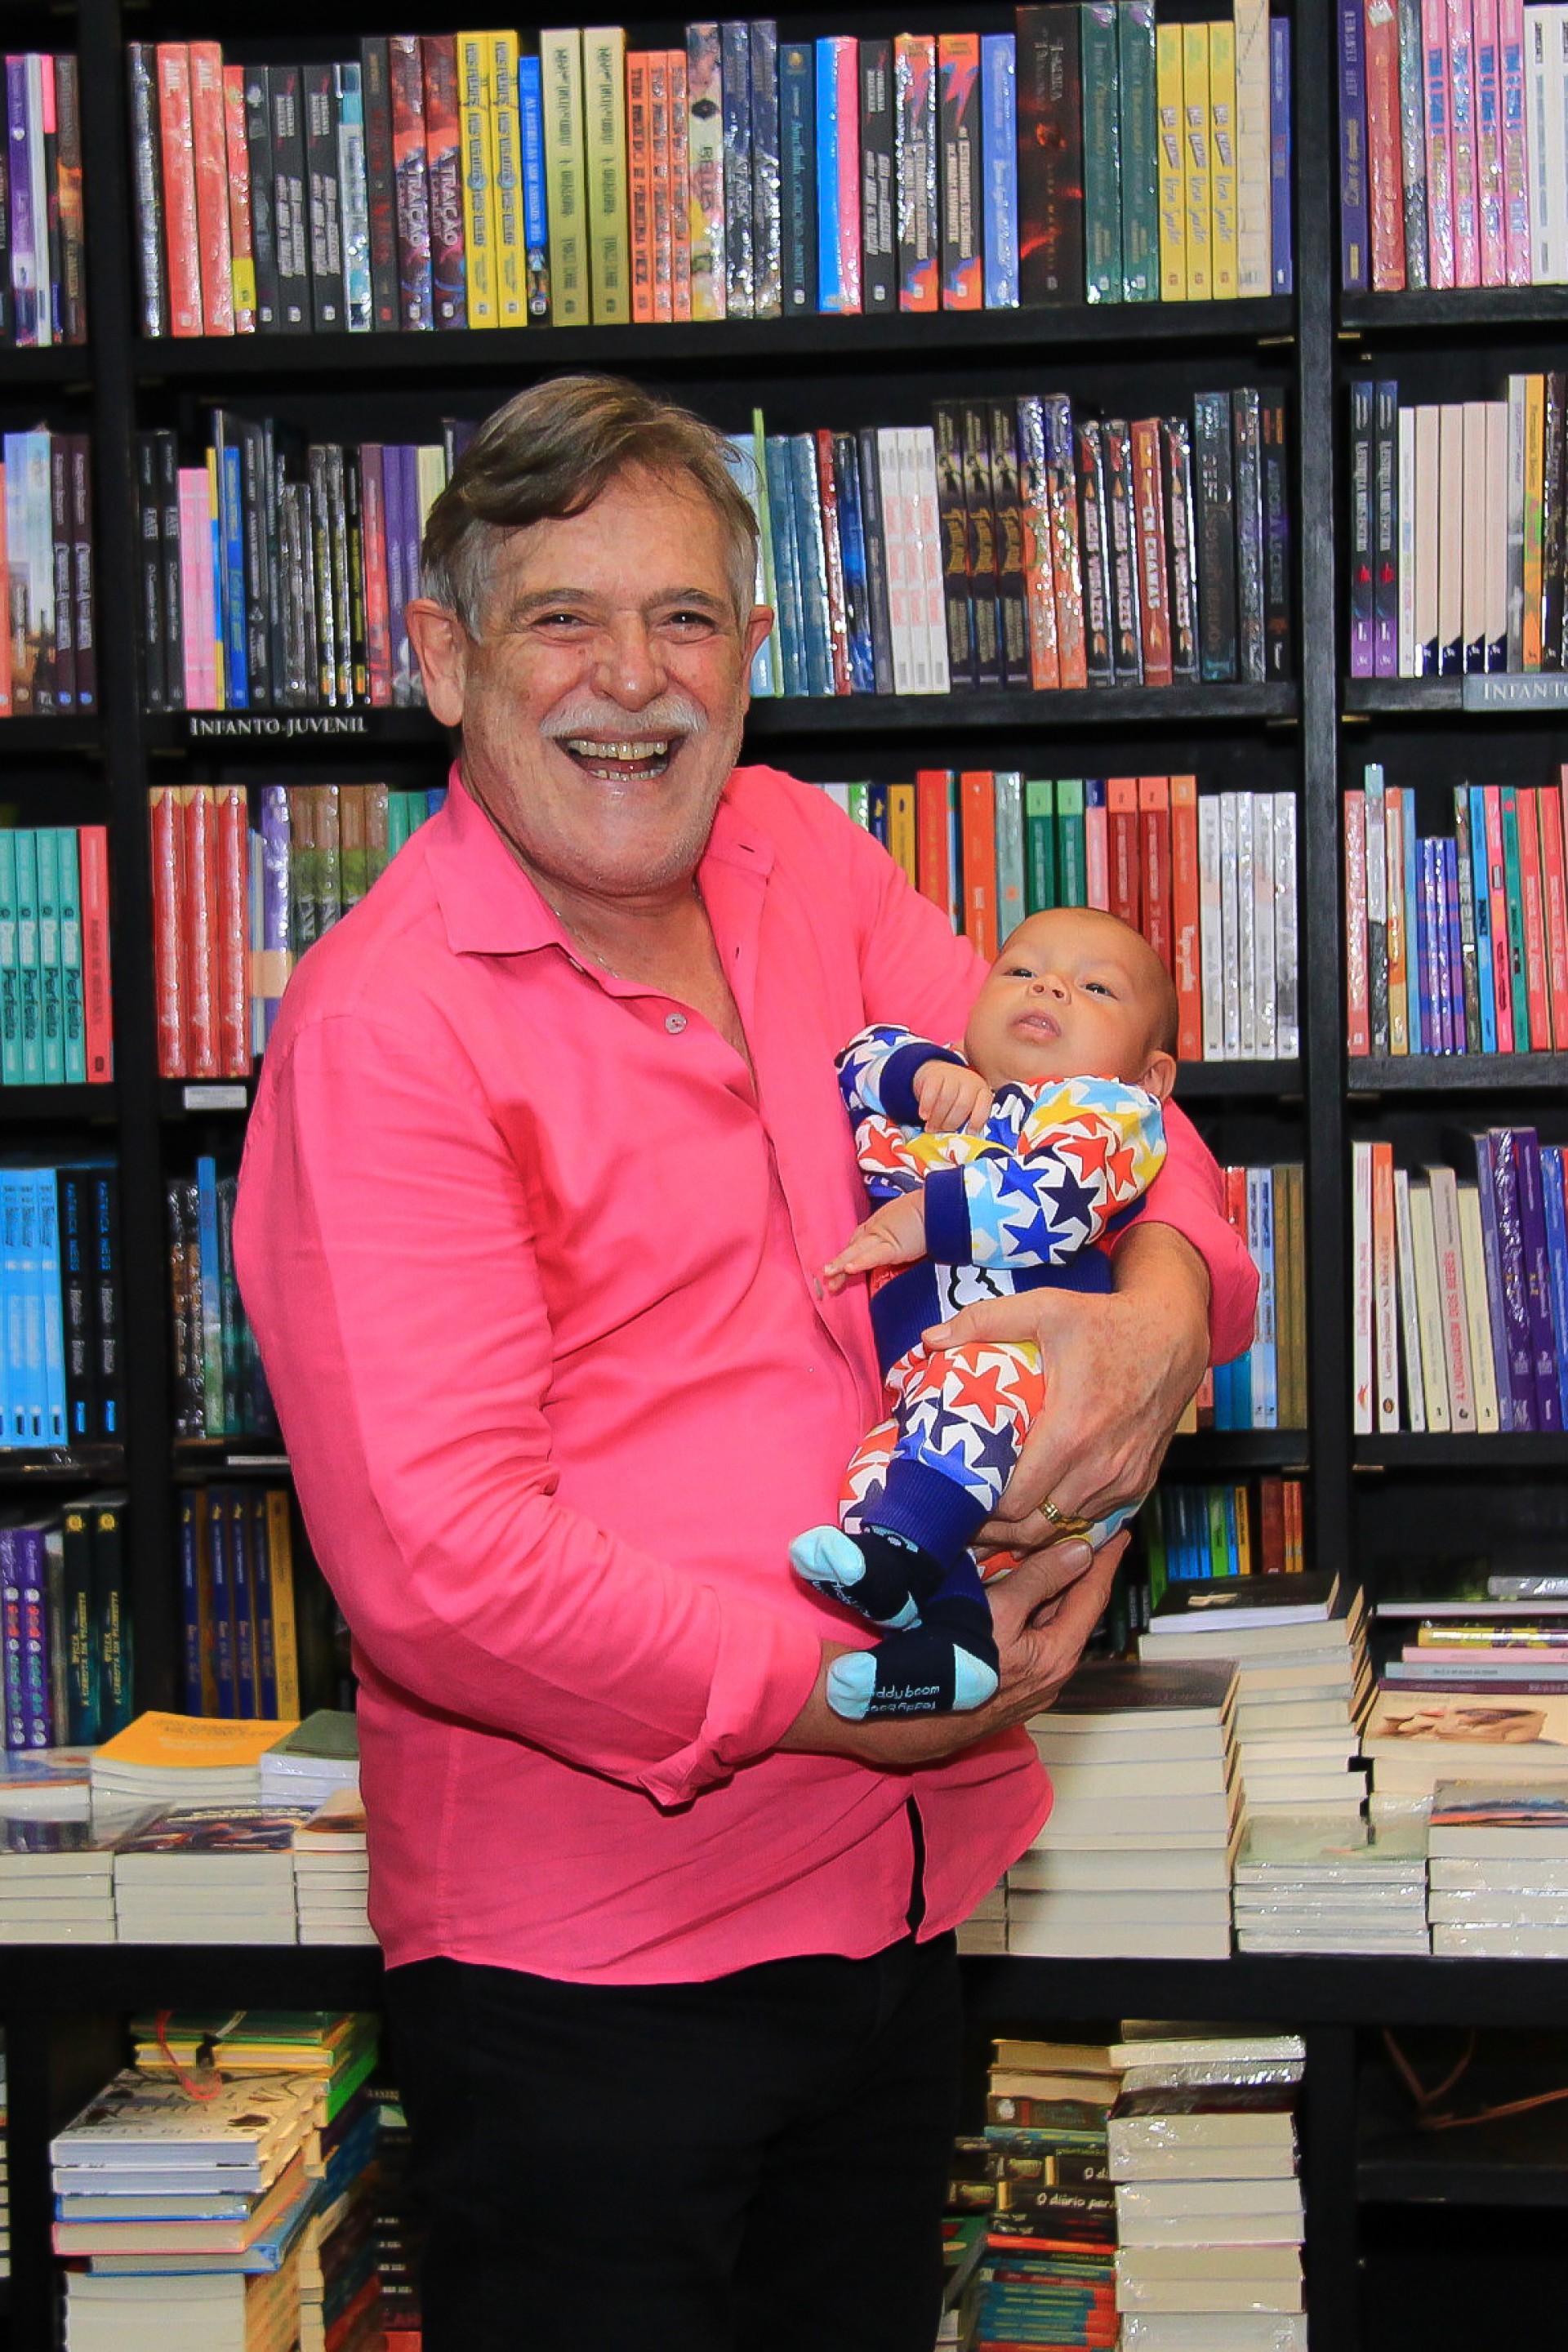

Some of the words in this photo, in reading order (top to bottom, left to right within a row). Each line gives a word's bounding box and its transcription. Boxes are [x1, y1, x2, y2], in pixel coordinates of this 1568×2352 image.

[1143, 506, 1156, 531] EM
[1145, 537, 1160, 609] CHAMAS
[4, 969, 16, 1040] Perfeito
[24, 969, 38, 1040] Perfeito
[44, 968, 59, 1038] Perfeito
[66, 969, 82, 1040] Perfeito
[1036, 2192, 1048, 2205] O
